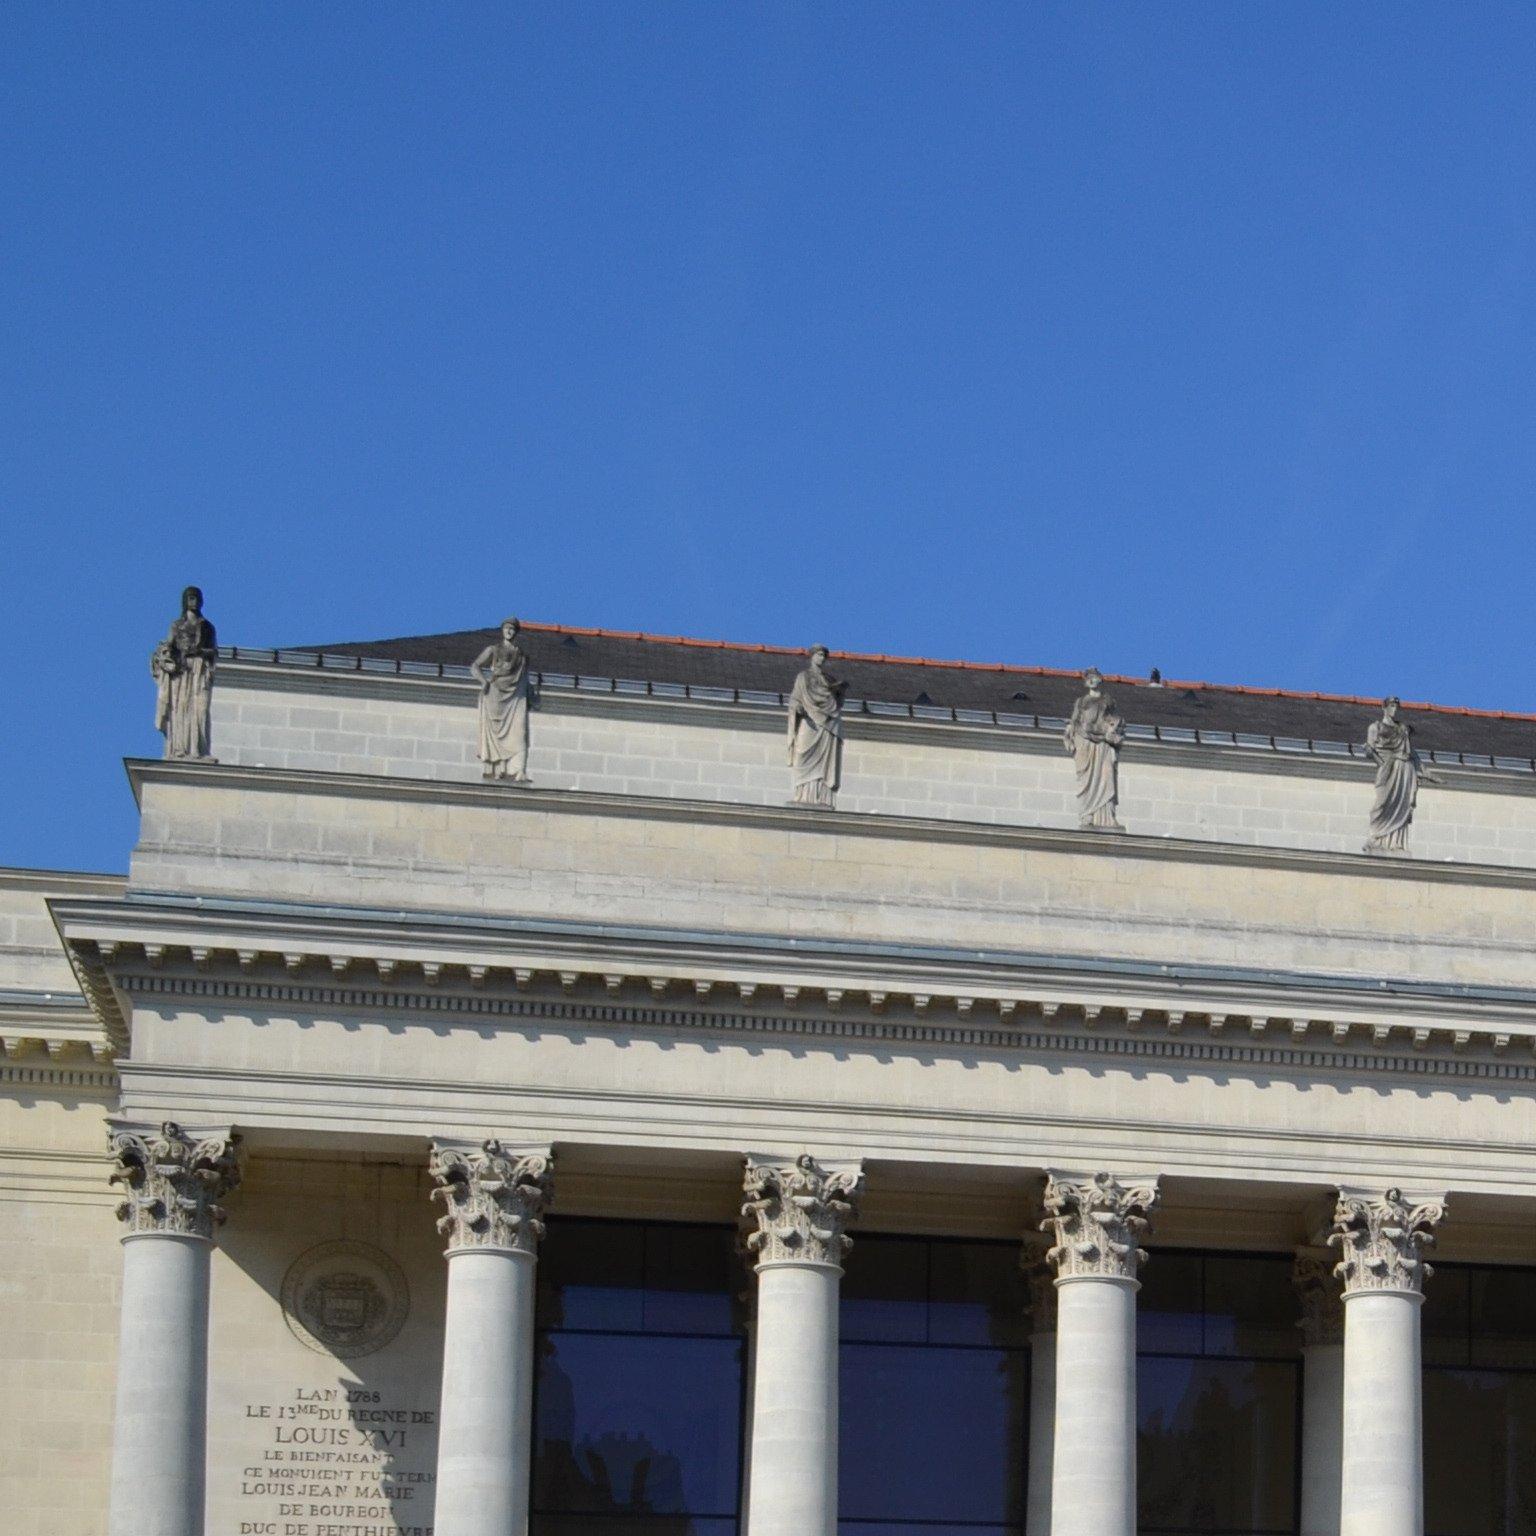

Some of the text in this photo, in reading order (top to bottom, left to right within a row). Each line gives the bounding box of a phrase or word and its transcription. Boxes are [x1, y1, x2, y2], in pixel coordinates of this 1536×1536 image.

[346, 1391, 381, 1403] 1788
[246, 1405, 271, 1418] LE
[318, 1408, 343, 1421] DU
[411, 1411, 434, 1424] DE
[275, 1426, 407, 1447] LOUIS XVI
[264, 1450, 394, 1464] LE BIENFAISANT
[244, 1467, 263, 1478] CE
[269, 1468, 354, 1481] MONUMENT
[241, 1483, 414, 1500] LOUIS JEAN MARIE
[279, 1503, 394, 1519] DE BOURBON
[240, 1522, 277, 1535] DUC
[285, 1523, 309, 1536] DE
